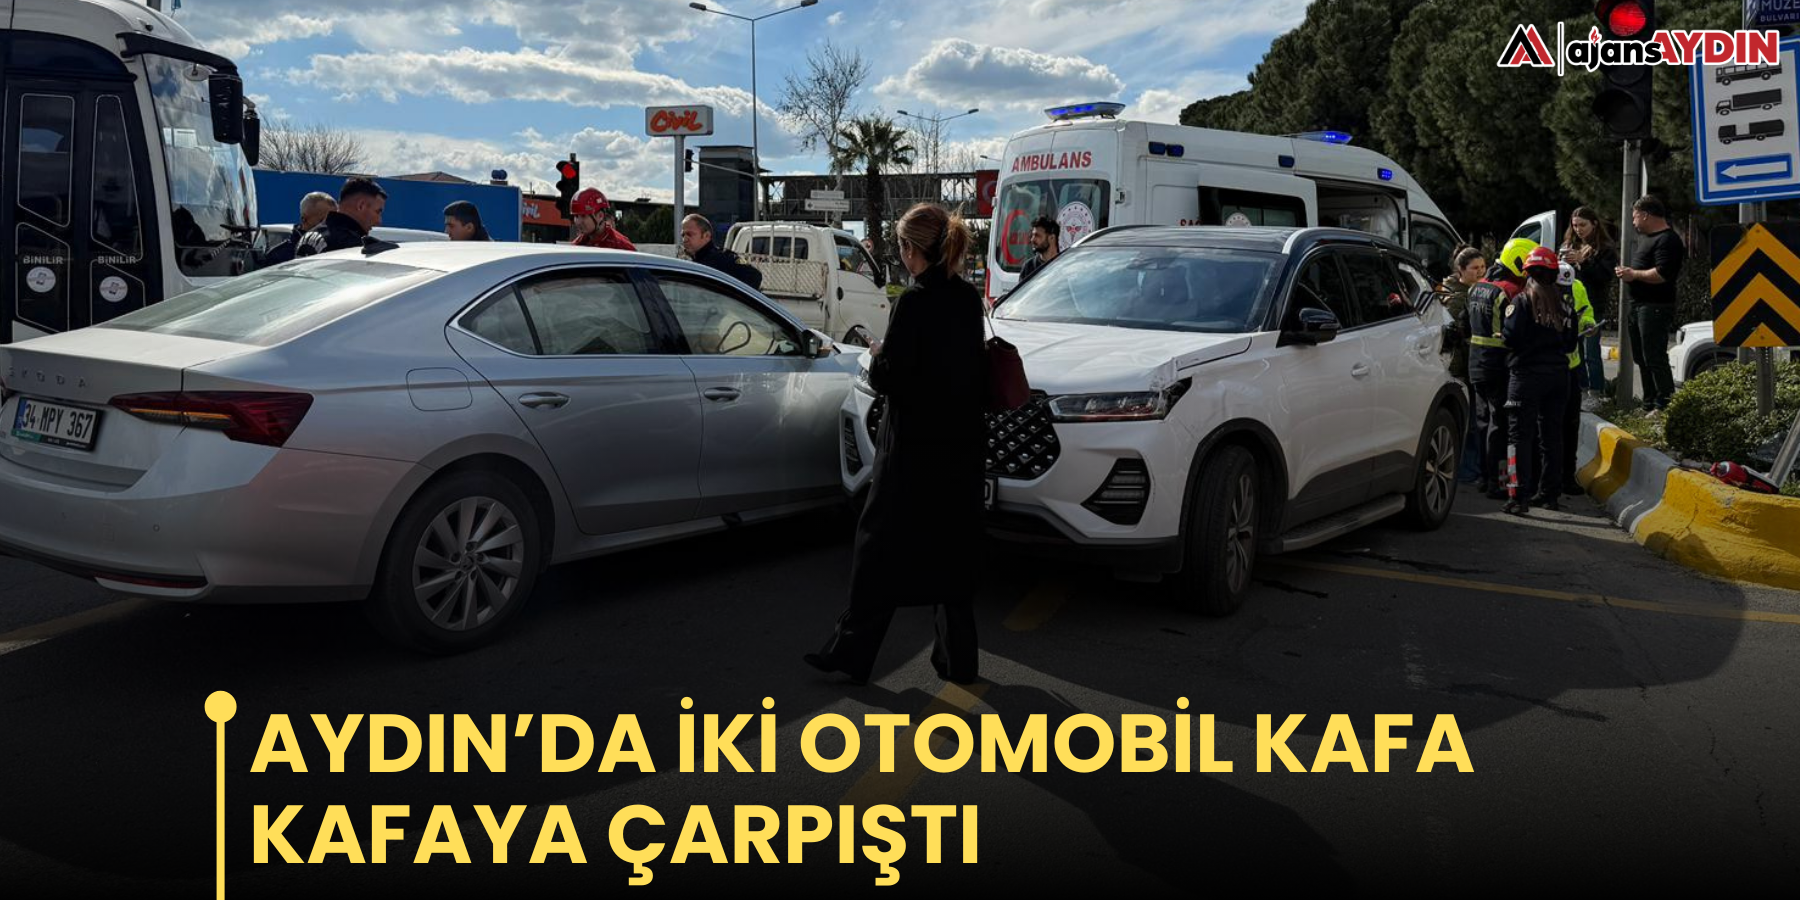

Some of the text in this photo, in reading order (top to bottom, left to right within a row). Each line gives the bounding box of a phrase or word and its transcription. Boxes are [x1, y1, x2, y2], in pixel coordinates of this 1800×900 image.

[1012, 151, 1092, 172] AMBULANS
[23, 403, 94, 439] 34 MPY 367
